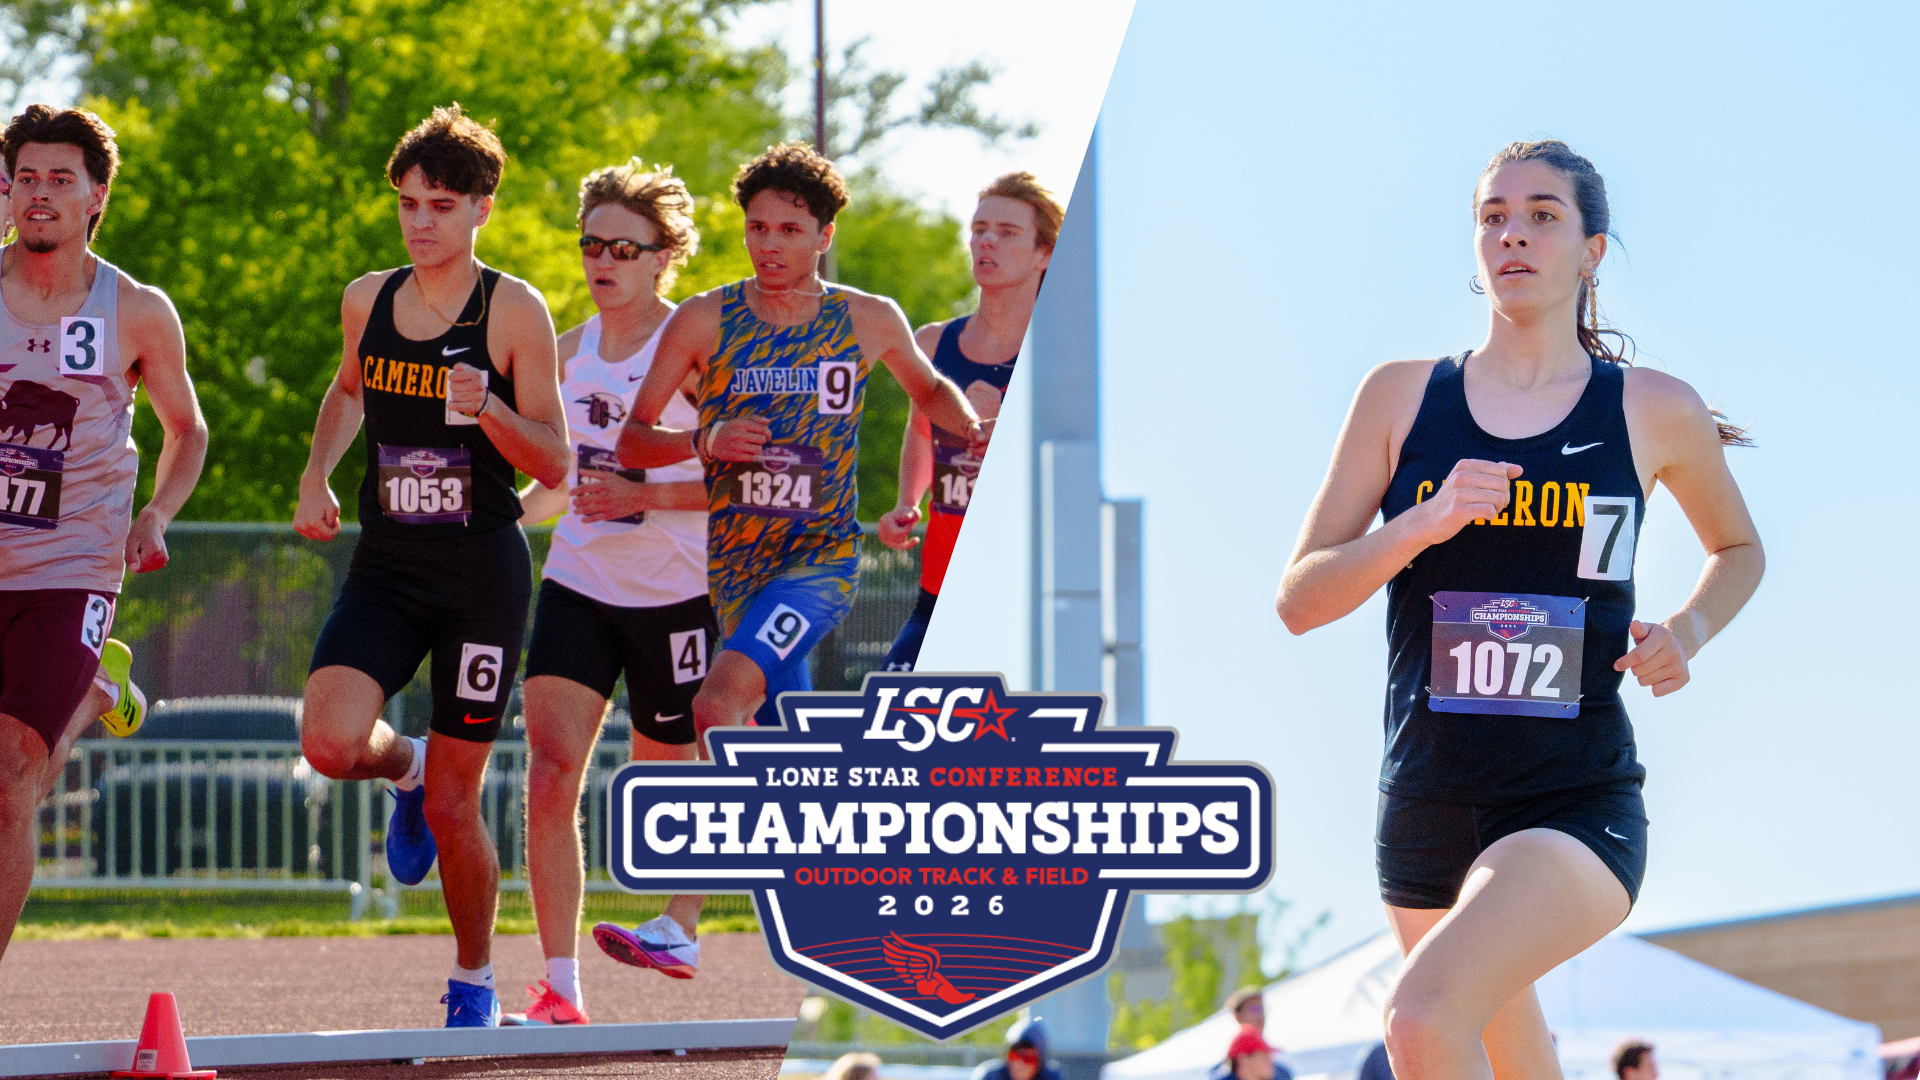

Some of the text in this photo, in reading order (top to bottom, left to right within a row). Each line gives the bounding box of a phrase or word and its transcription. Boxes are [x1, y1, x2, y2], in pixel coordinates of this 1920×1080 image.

[65, 319, 97, 371] 3
[364, 355, 450, 399] CAMERO
[730, 367, 820, 394] JAVELIN
[826, 365, 851, 411] 9
[385, 476, 464, 513] 1053
[738, 470, 813, 509] 1324
[1592, 503, 1629, 574] 7
[86, 598, 108, 649] 3
[767, 611, 802, 650] 9
[1473, 612, 1545, 622] CHAMPIONSHIPS
[466, 653, 498, 693] 6
[677, 634, 702, 677] 4
[1449, 640, 1565, 698] 1072
